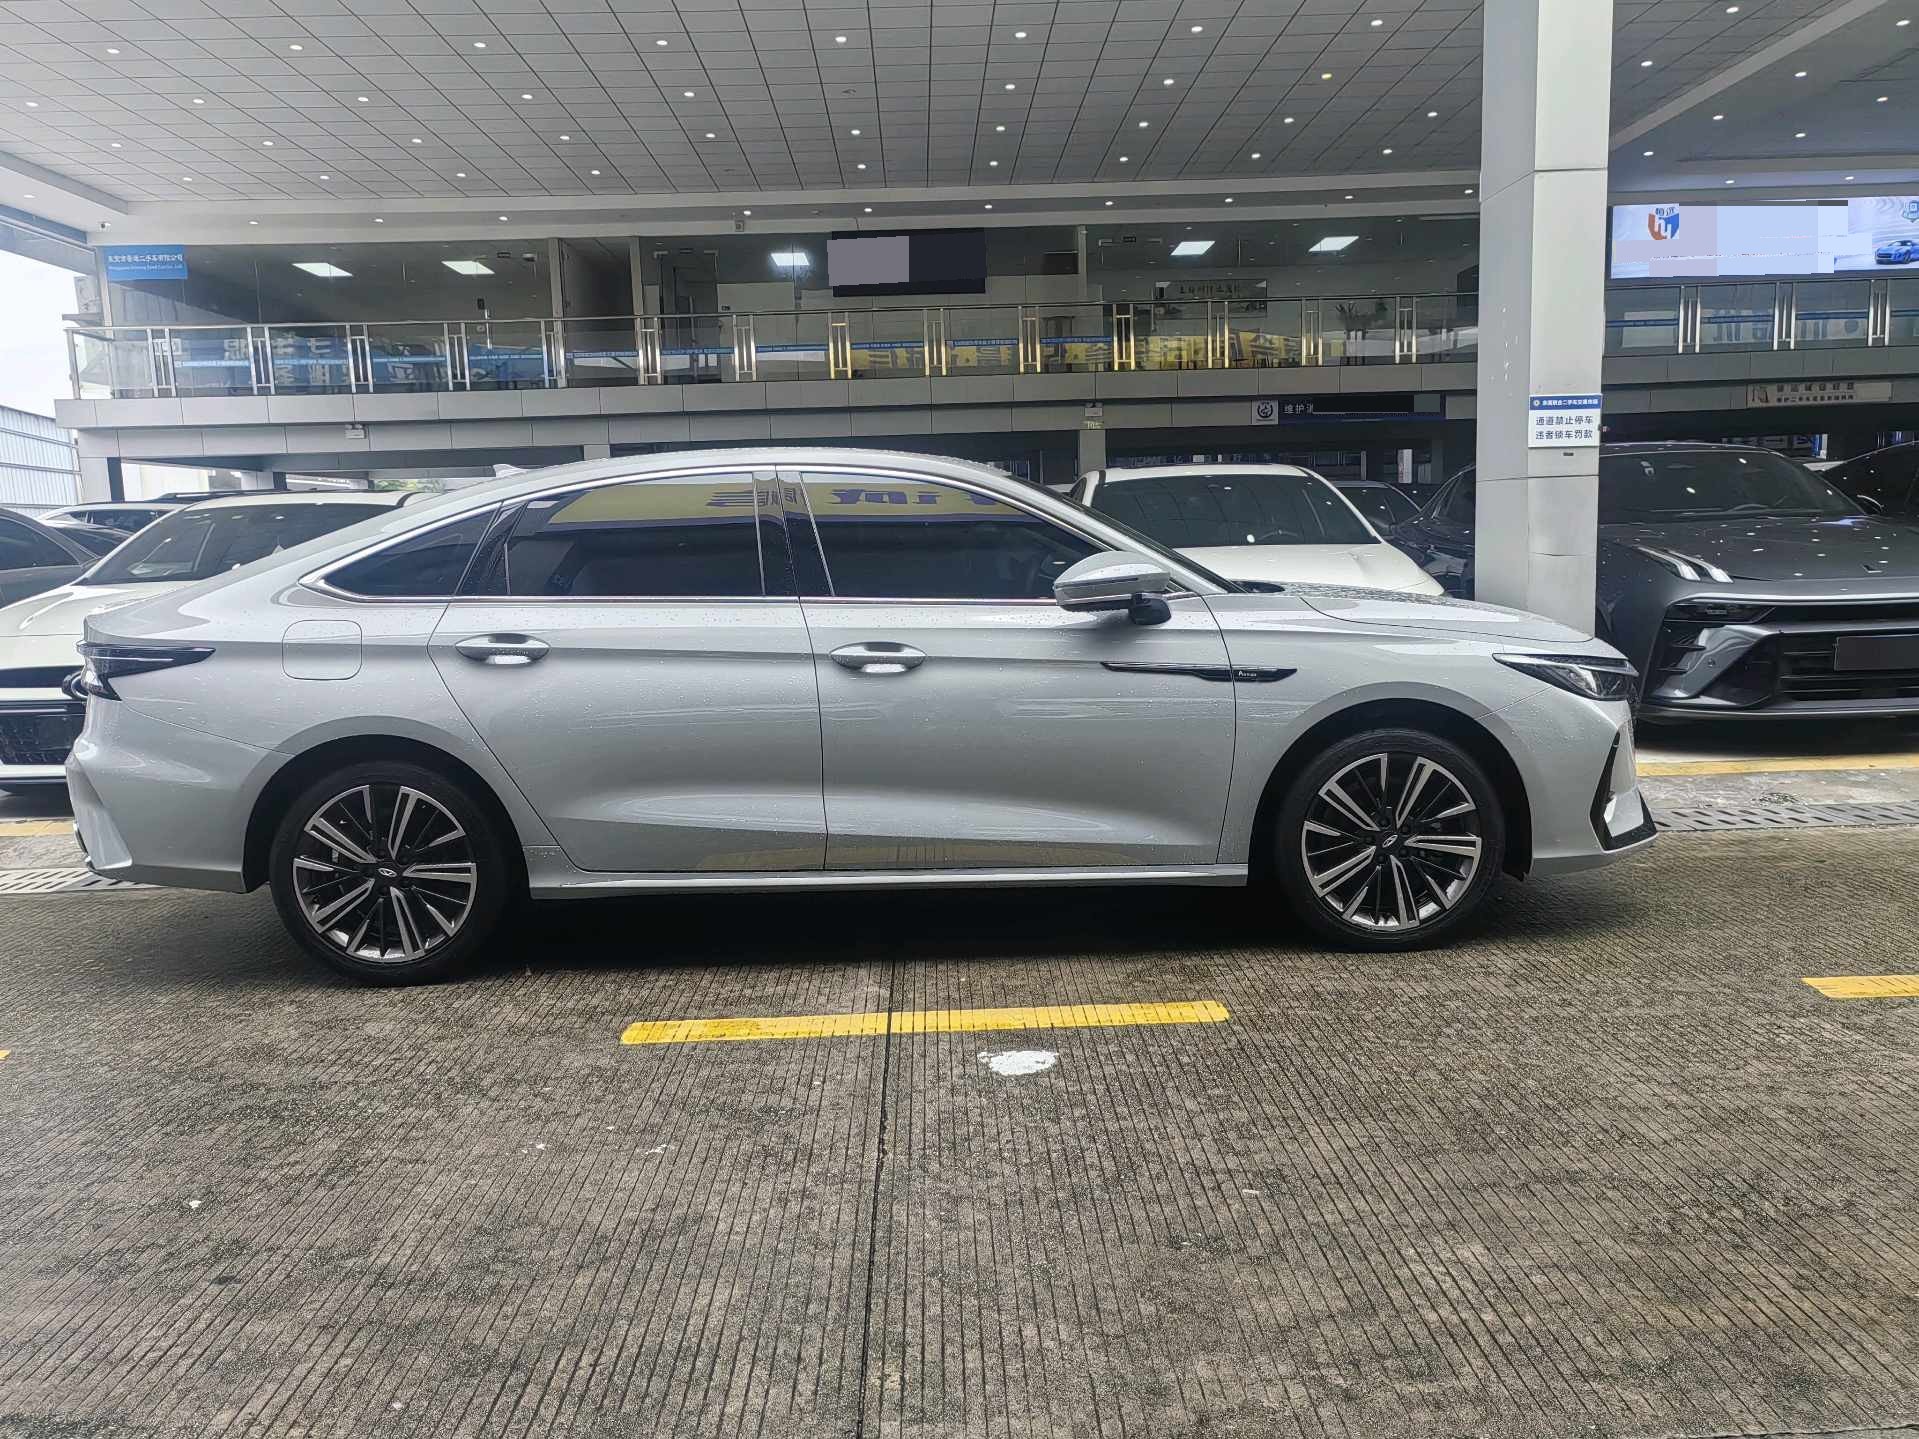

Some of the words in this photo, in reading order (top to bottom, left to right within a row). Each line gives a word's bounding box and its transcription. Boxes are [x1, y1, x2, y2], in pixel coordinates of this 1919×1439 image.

[1535, 415, 1594, 426] 通道禁止停车
[1535, 429, 1593, 440] 违者锁车罚款
